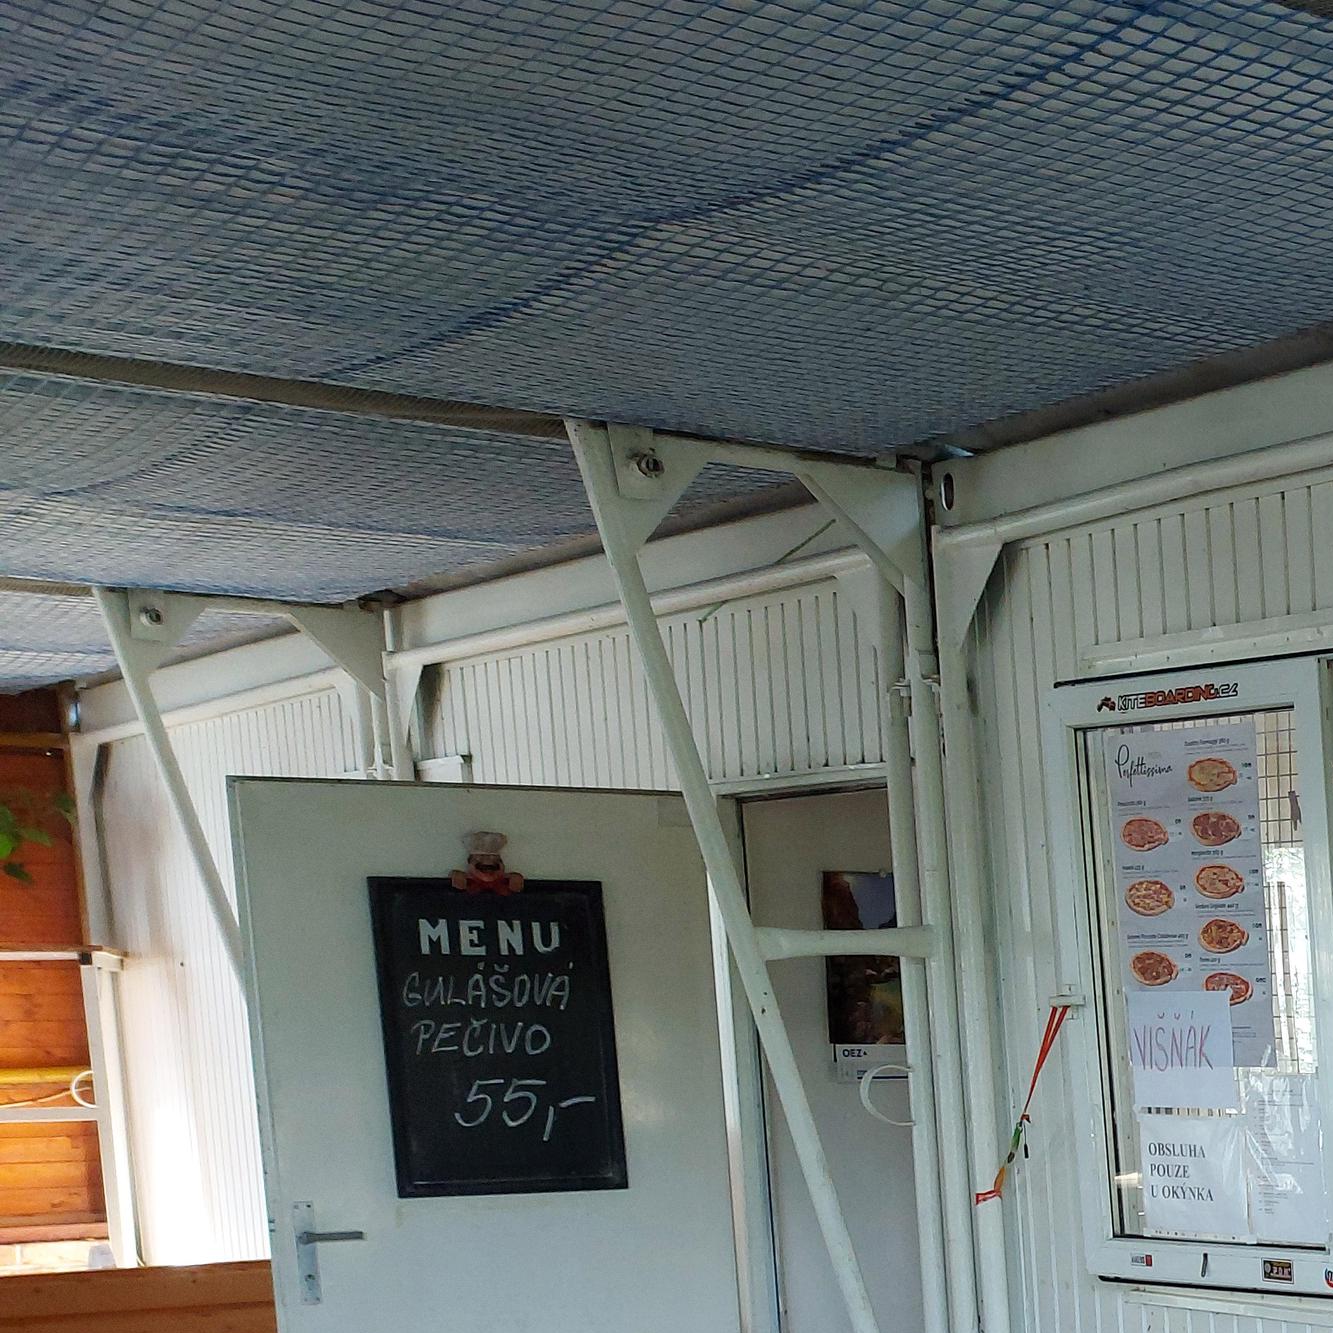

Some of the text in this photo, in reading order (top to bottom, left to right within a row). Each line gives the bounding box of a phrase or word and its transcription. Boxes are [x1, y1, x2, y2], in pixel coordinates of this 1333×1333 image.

[419, 918, 560, 956] MENU
[403, 962, 574, 1011] GULÁŠOVÁ
[411, 1018, 551, 1058] PEČIVO
[1133, 1009, 1214, 1072] VIŠŇÁK
[455, 1079, 596, 1141] 55,-
[1148, 1142, 1206, 1159] OBSLUHA
[1150, 1163, 1190, 1179] POUZE
[1151, 1181, 1214, 1201] U OKÝNKA
